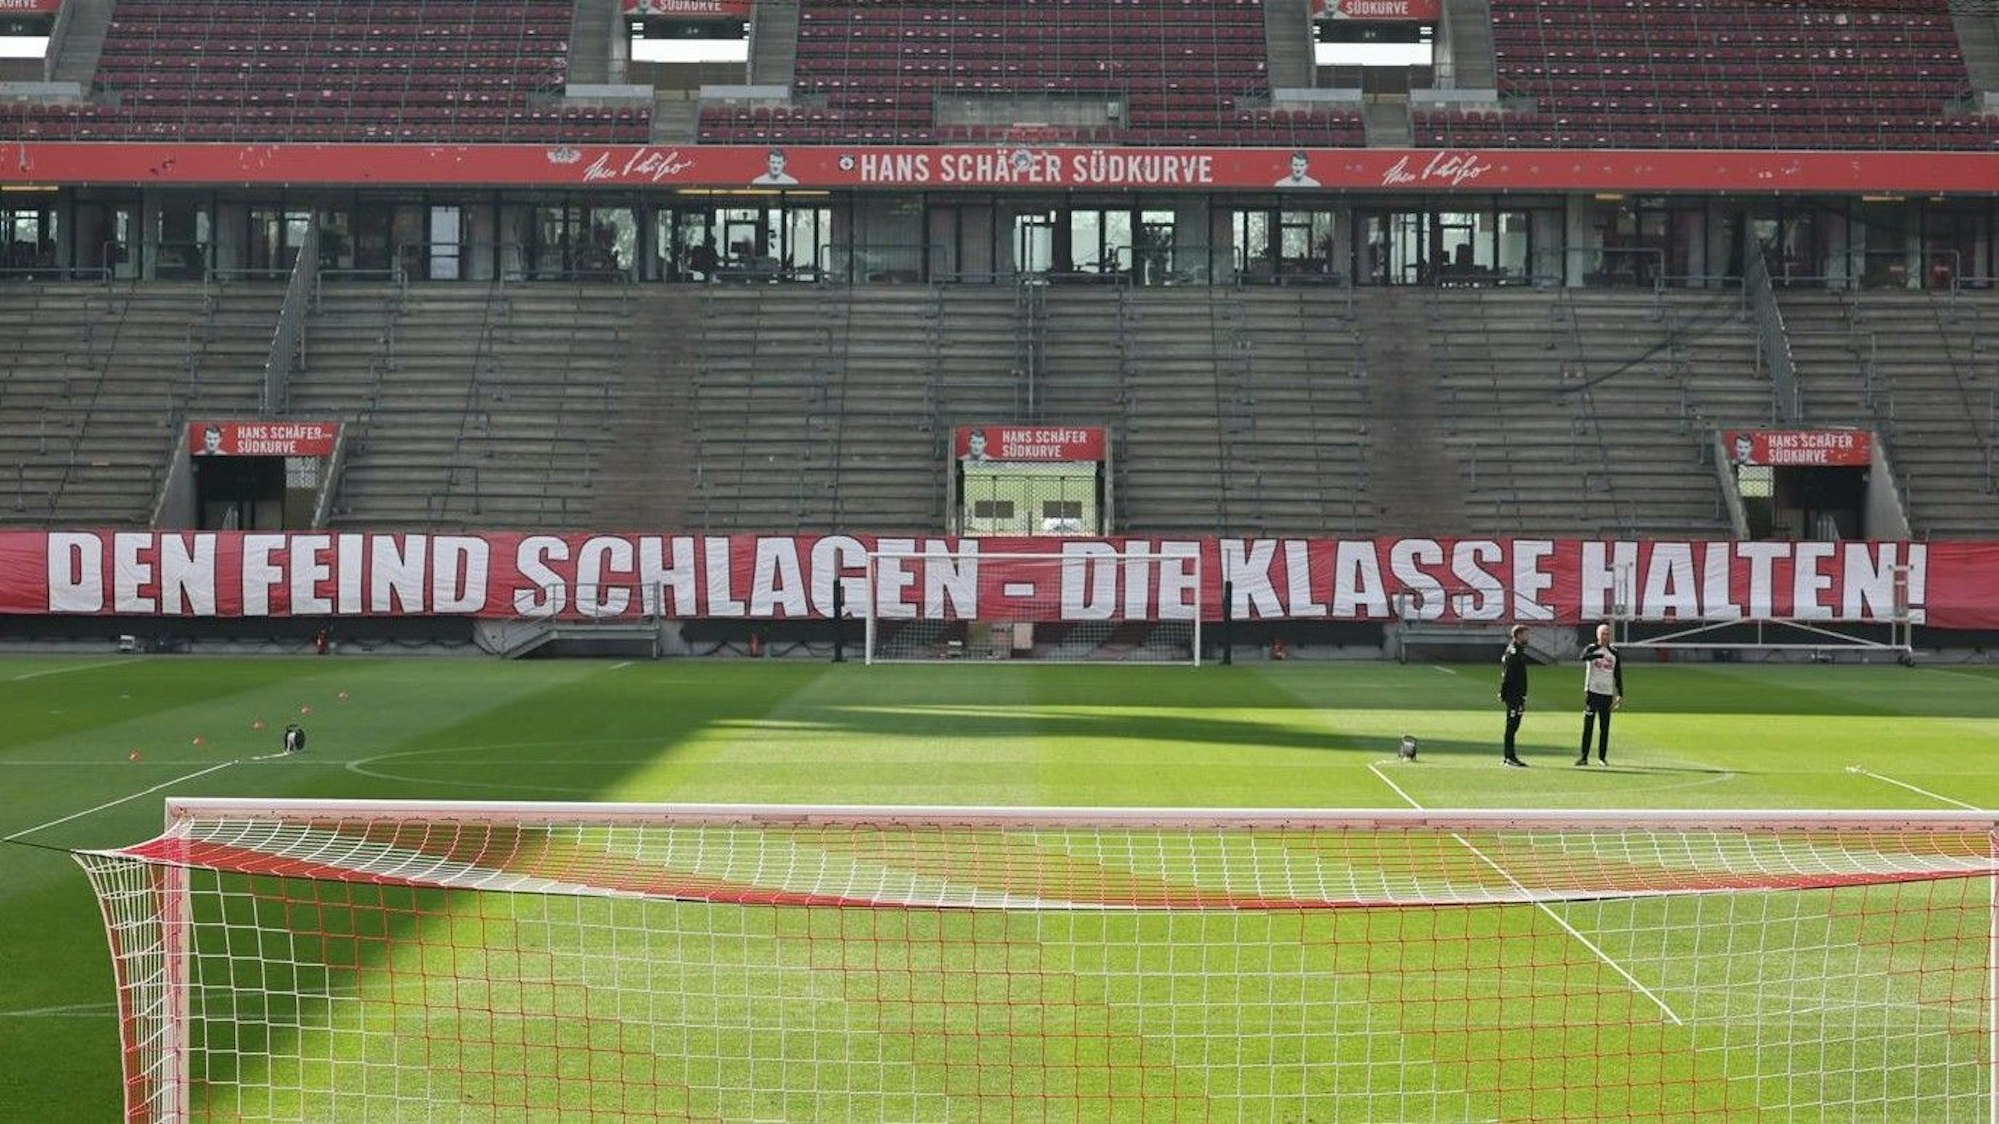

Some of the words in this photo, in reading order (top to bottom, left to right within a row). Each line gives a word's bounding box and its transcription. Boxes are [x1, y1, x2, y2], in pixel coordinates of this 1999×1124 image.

[861, 154, 930, 182] HANS
[1073, 150, 1213, 183] SÜDKURVE
[238, 426, 267, 439] HANS
[270, 424, 322, 439] SCHÄFER
[1002, 430, 1032, 443] HANS
[1035, 428, 1087, 443] SCHÄFER
[238, 438, 296, 454] SÜDKURVE
[1768, 435, 1800, 448] HANS
[1802, 433, 1853, 448] SCHÄFER
[1002, 444, 1061, 458] SÜDKURVE
[1768, 447, 1827, 464] SÜDKURVE
[47, 532, 216, 616] DEN
[242, 533, 489, 616] FEIND
[513, 534, 979, 620] SCHLAGEN
[1004, 583, 1035, 597] -
[1060, 540, 1201, 620] DIE
[1220, 538, 1555, 621] KLASSE
[1579, 540, 1928, 625] HALTEN!
